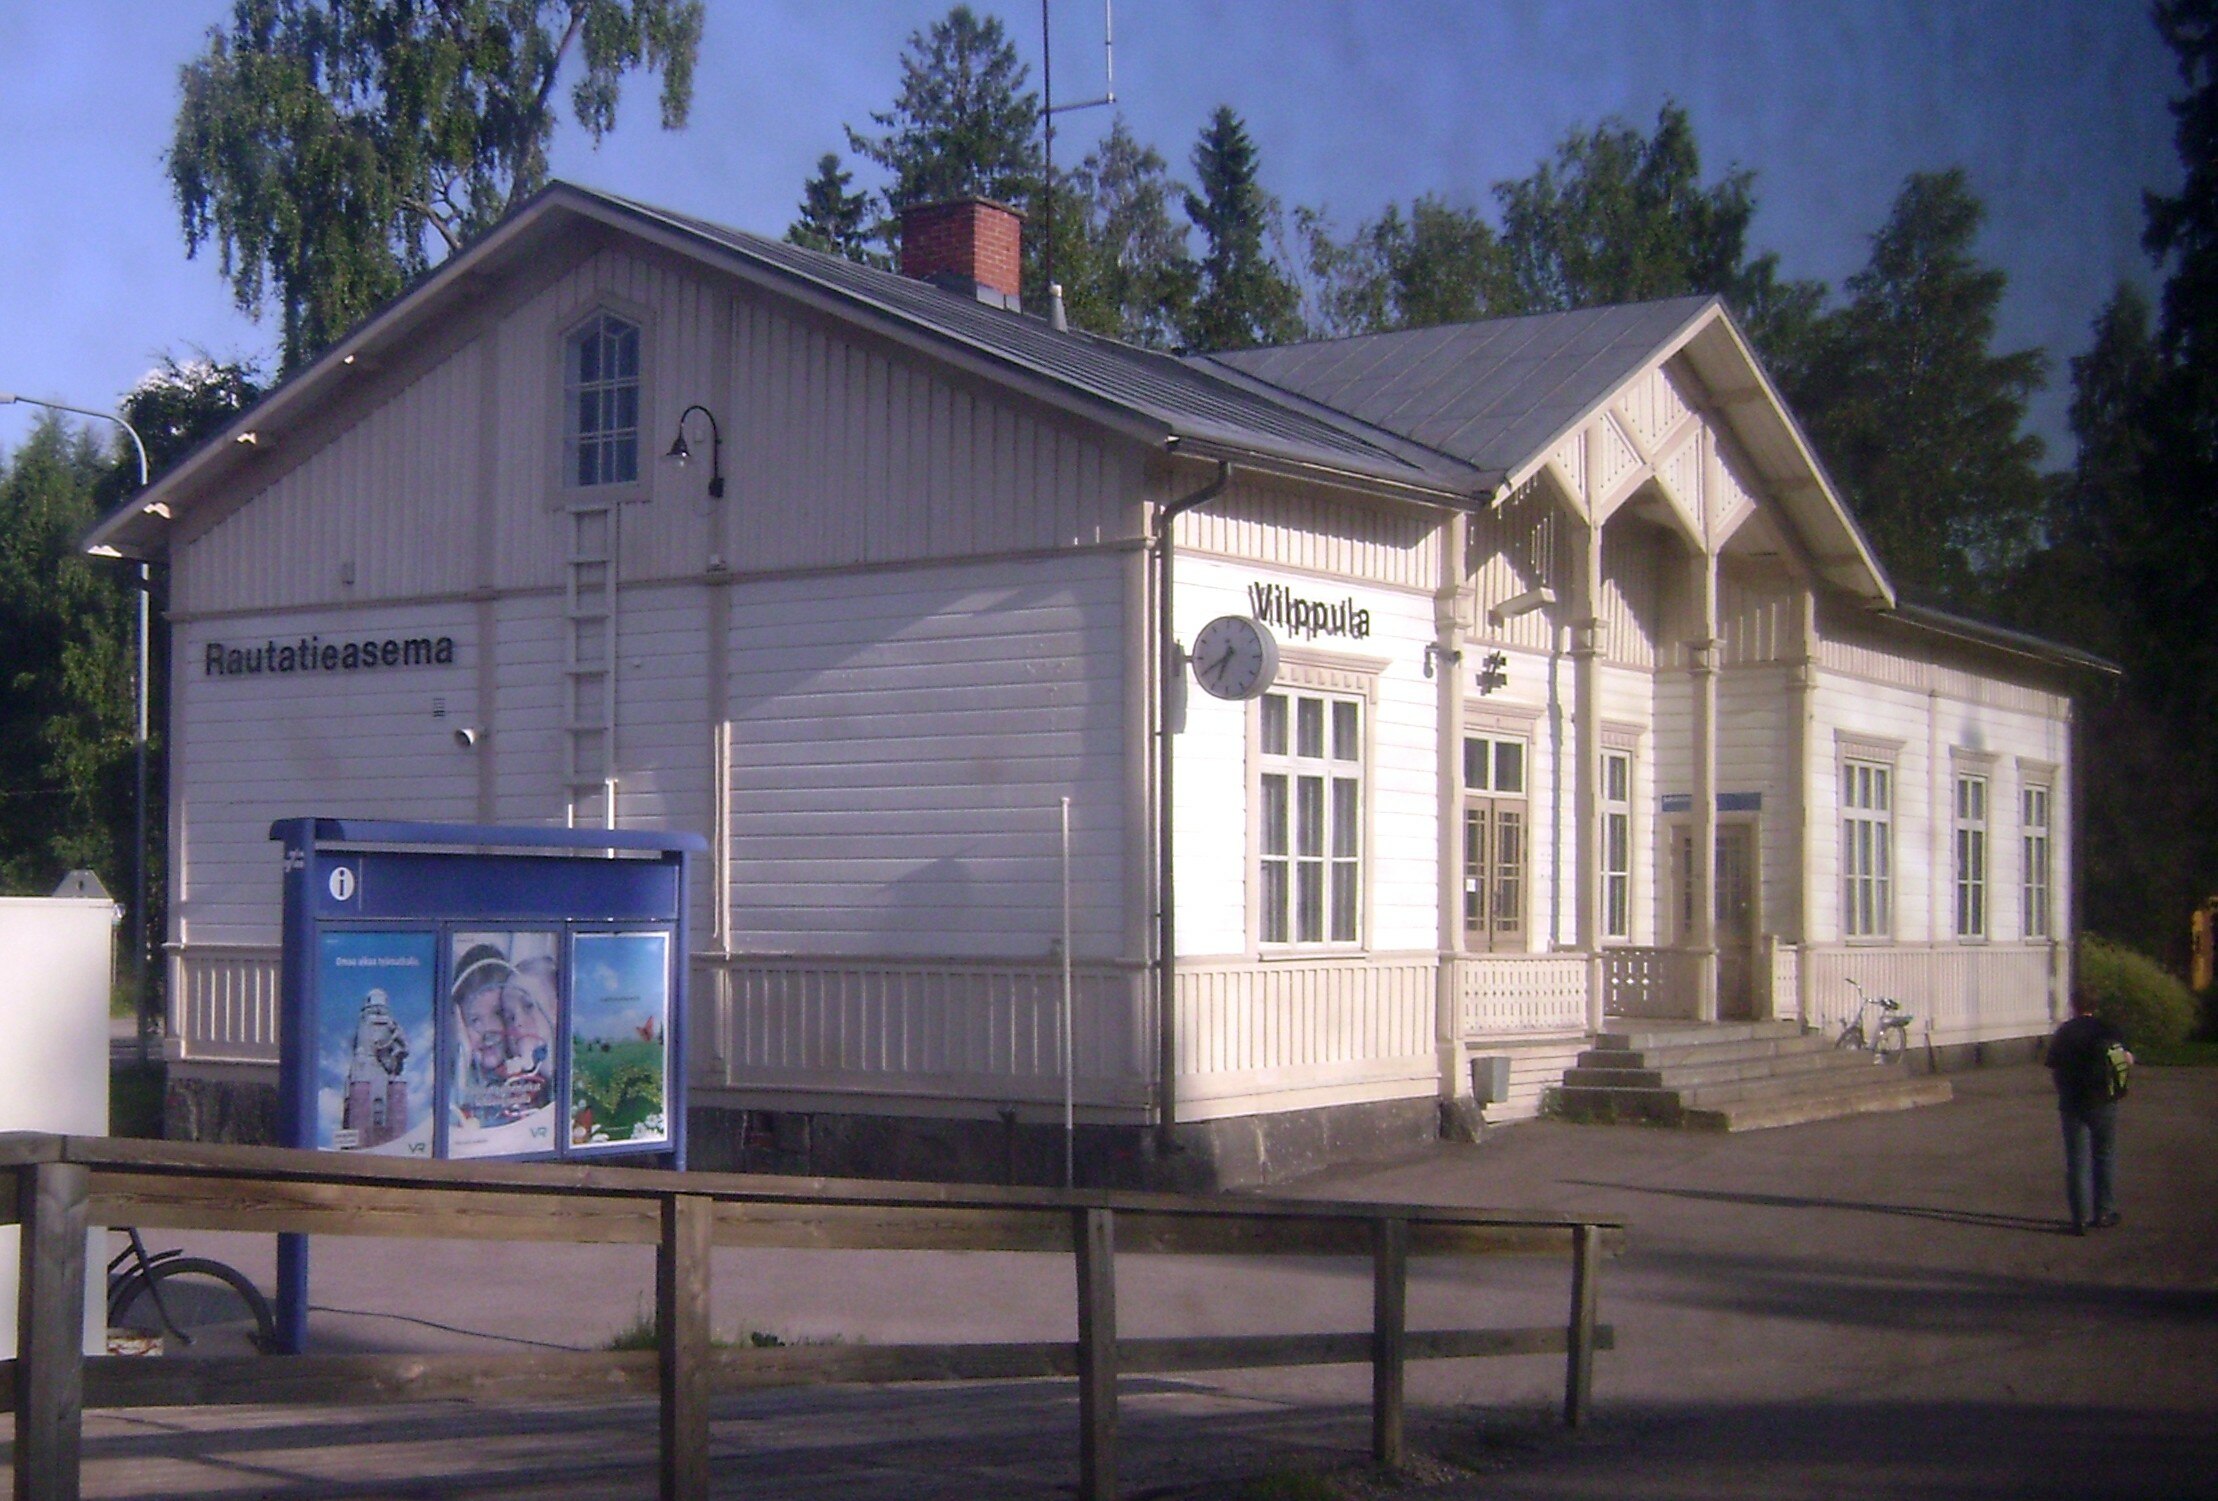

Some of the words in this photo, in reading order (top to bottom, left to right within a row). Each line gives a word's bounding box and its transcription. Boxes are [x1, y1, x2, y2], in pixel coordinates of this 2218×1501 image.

[1253, 581, 1370, 639] Vilppula
[206, 635, 454, 675] Rautatieasema
[530, 1127, 547, 1138] VR
[408, 1143, 425, 1153] VR
